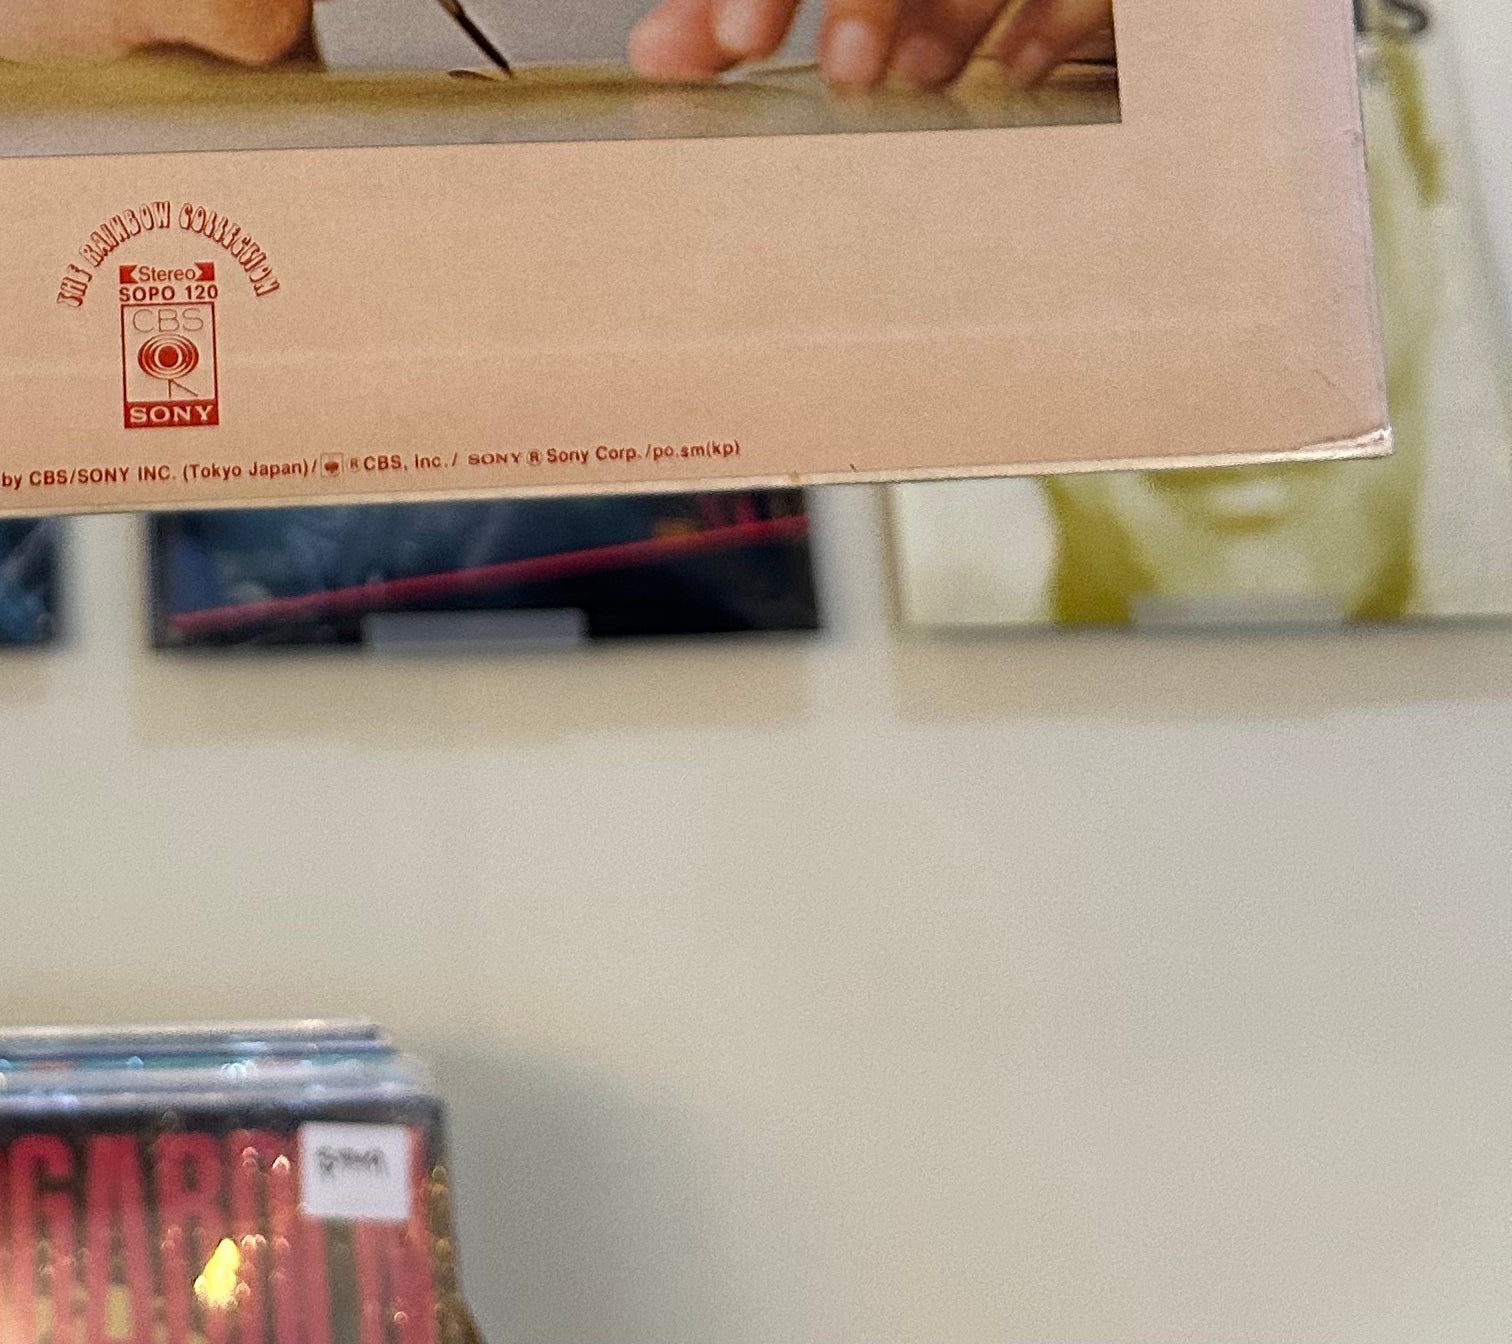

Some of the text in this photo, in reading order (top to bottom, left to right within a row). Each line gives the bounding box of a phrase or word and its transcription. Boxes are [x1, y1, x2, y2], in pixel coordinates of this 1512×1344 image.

[79, 201, 170, 268] RAINBOW
[179, 203, 280, 297] COLLECTION
[139, 266, 196, 282] Stereo
[119, 284, 218, 302] SOPO 120
[133, 308, 204, 333] CBS
[130, 405, 214, 423] SONY
[1, 471, 22, 491] by
[29, 467, 129, 486] CBS/SONY
[138, 464, 176, 481] INC.
[183, 462, 242, 482] (Tokyo
[468, 451, 520, 466] SONY
[547, 446, 589, 465] Sony
